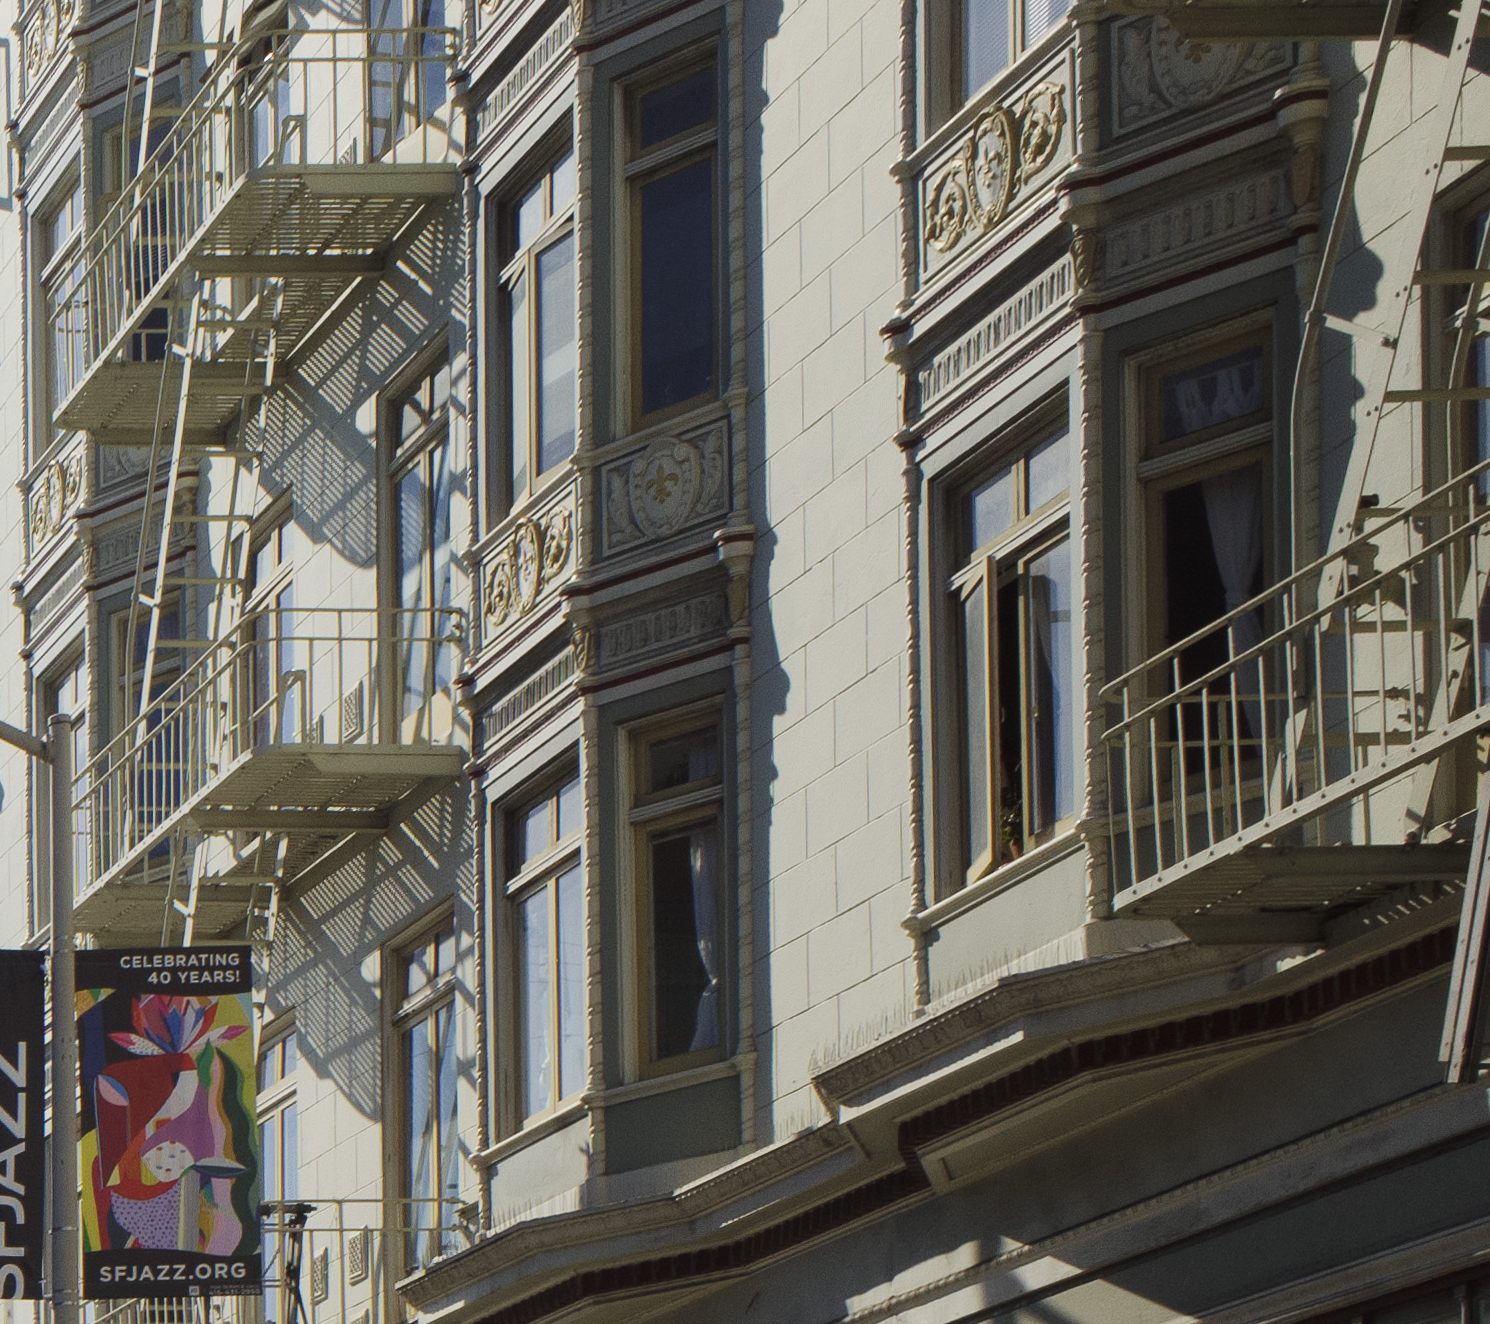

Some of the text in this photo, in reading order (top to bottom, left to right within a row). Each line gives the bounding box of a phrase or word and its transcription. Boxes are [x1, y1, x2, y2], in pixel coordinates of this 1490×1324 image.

[120, 954, 240, 969] CELEBRATING
[147, 969, 241, 985] 40 YEARS!
[99, 1262, 247, 1282] SFJAZZ.ORG
